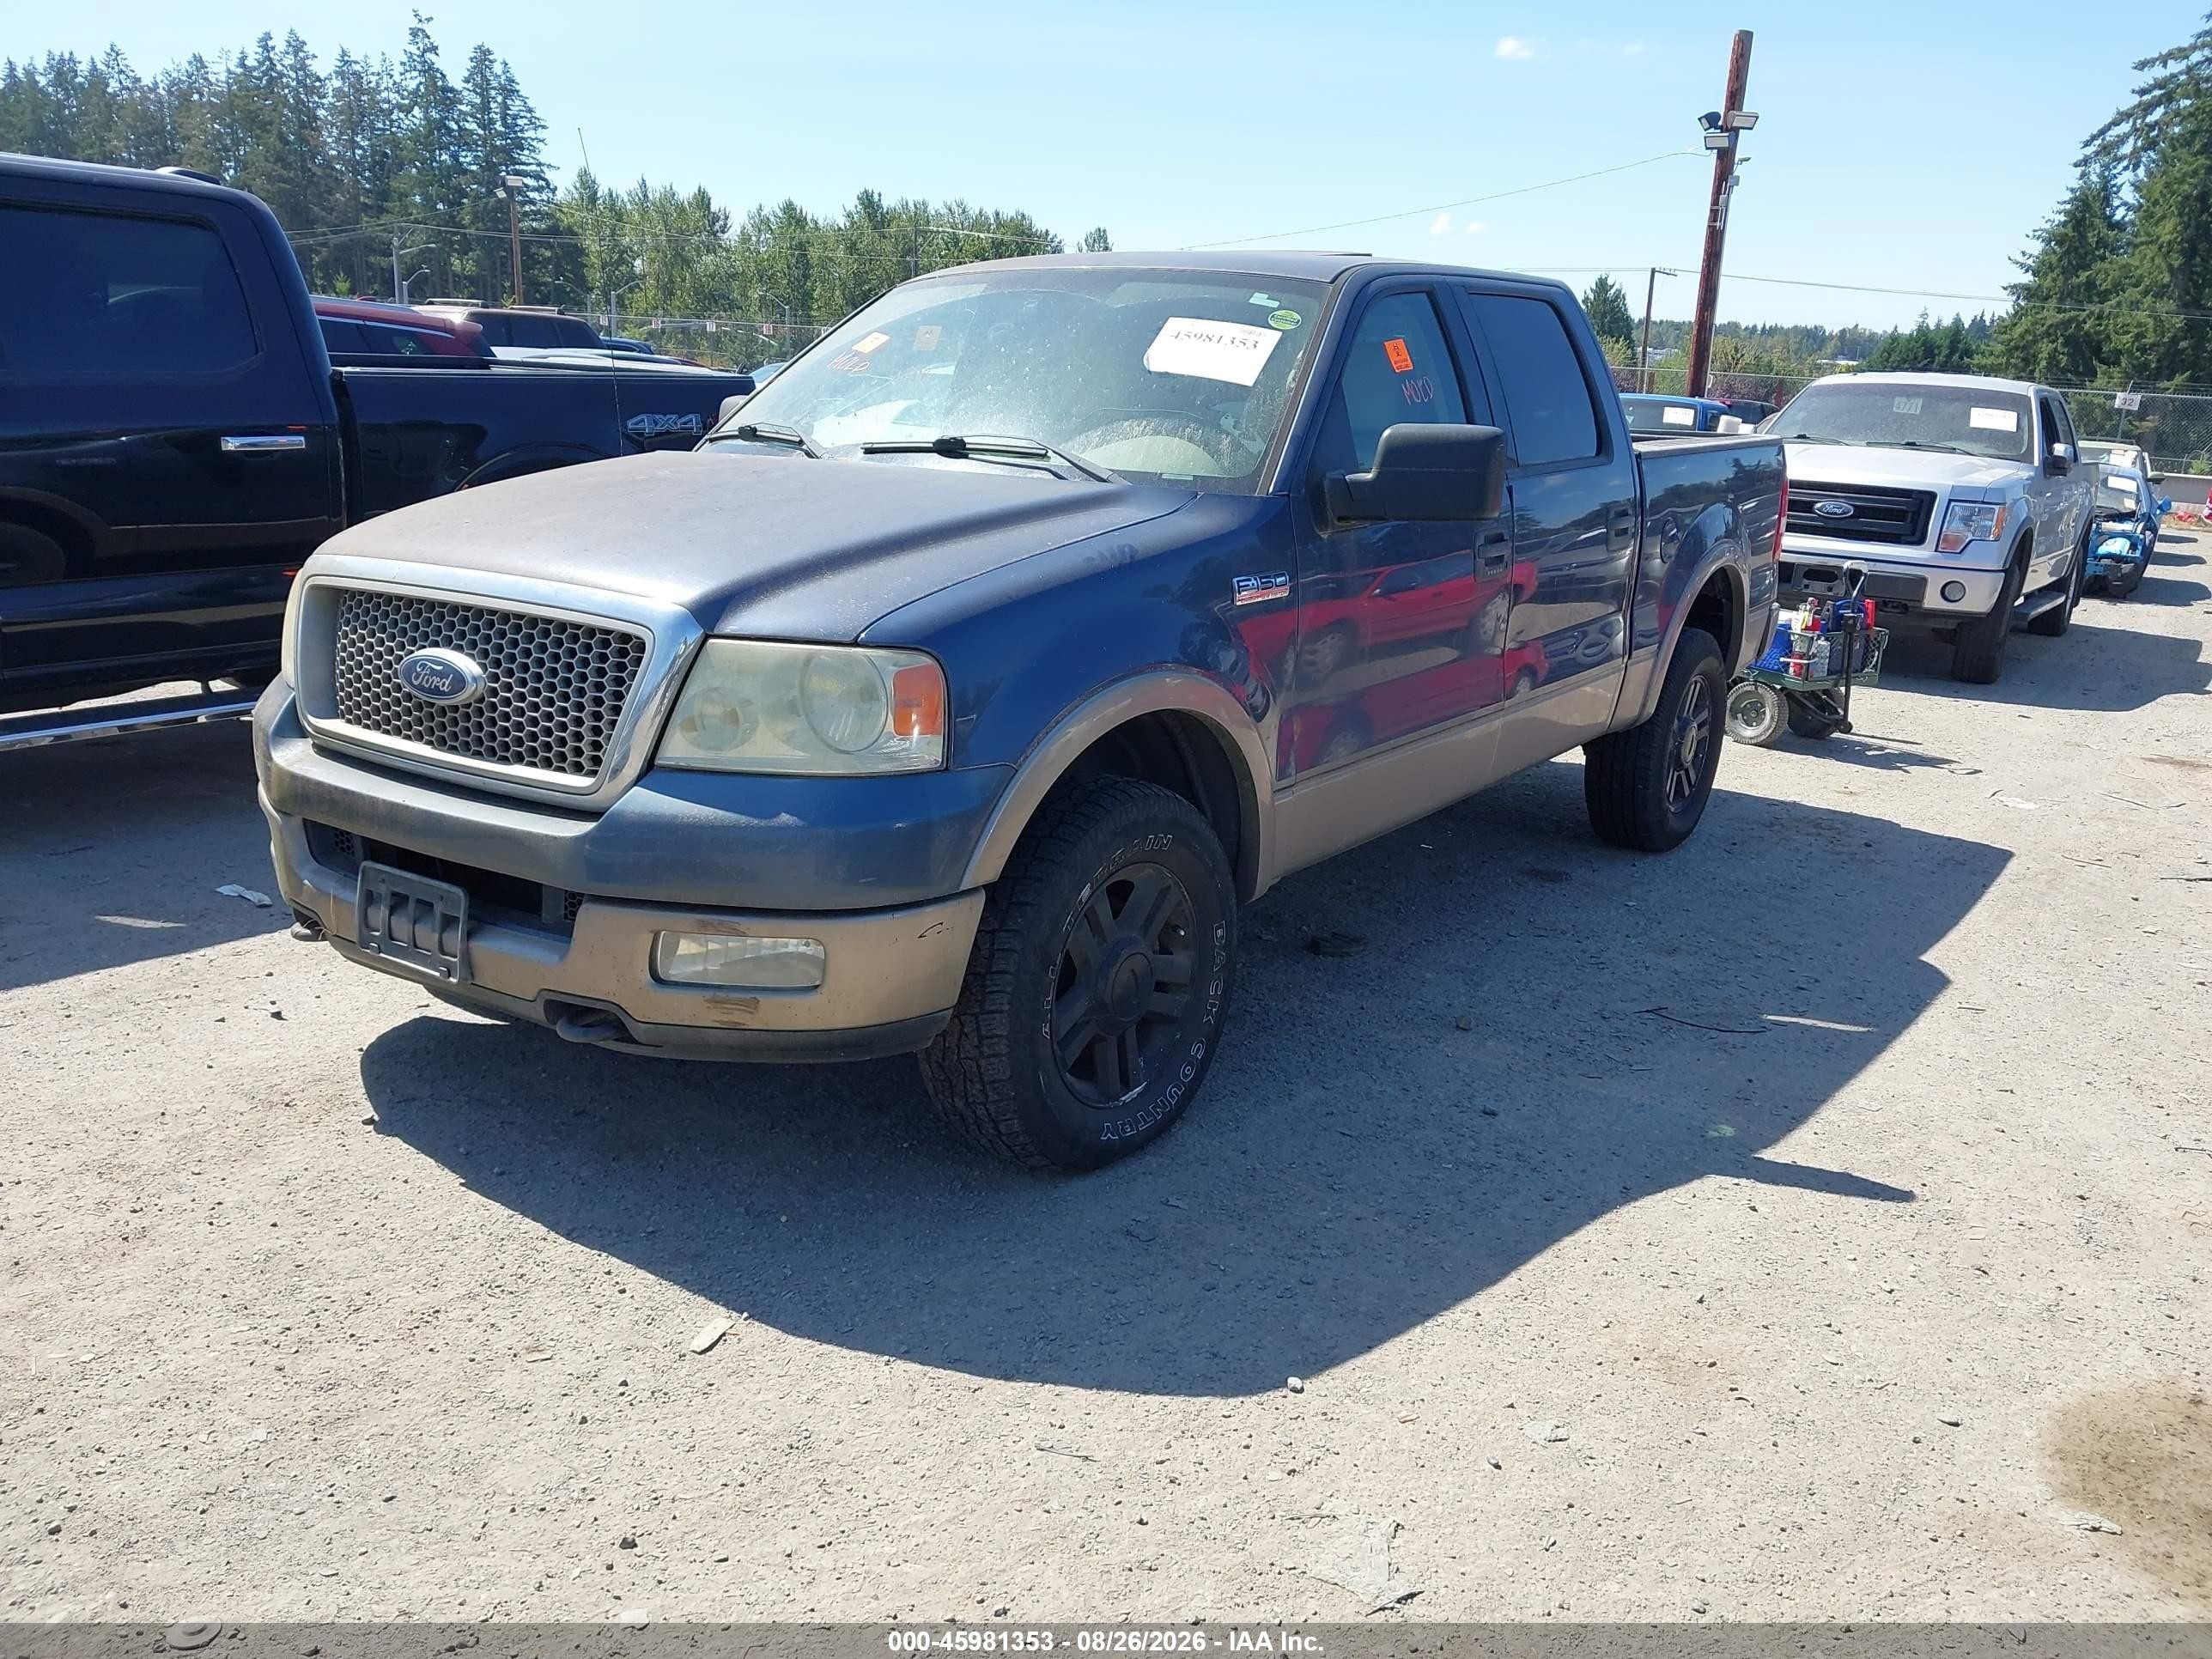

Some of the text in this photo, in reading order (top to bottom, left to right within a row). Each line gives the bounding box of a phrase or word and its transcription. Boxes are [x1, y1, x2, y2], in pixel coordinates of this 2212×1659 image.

[1170, 330, 1260, 350] 45981353
[2121, 398, 2134, 406] 32
[411, 660, 453, 692] Ford
[1100, 920, 1227, 1140] BACK COUNTRY
